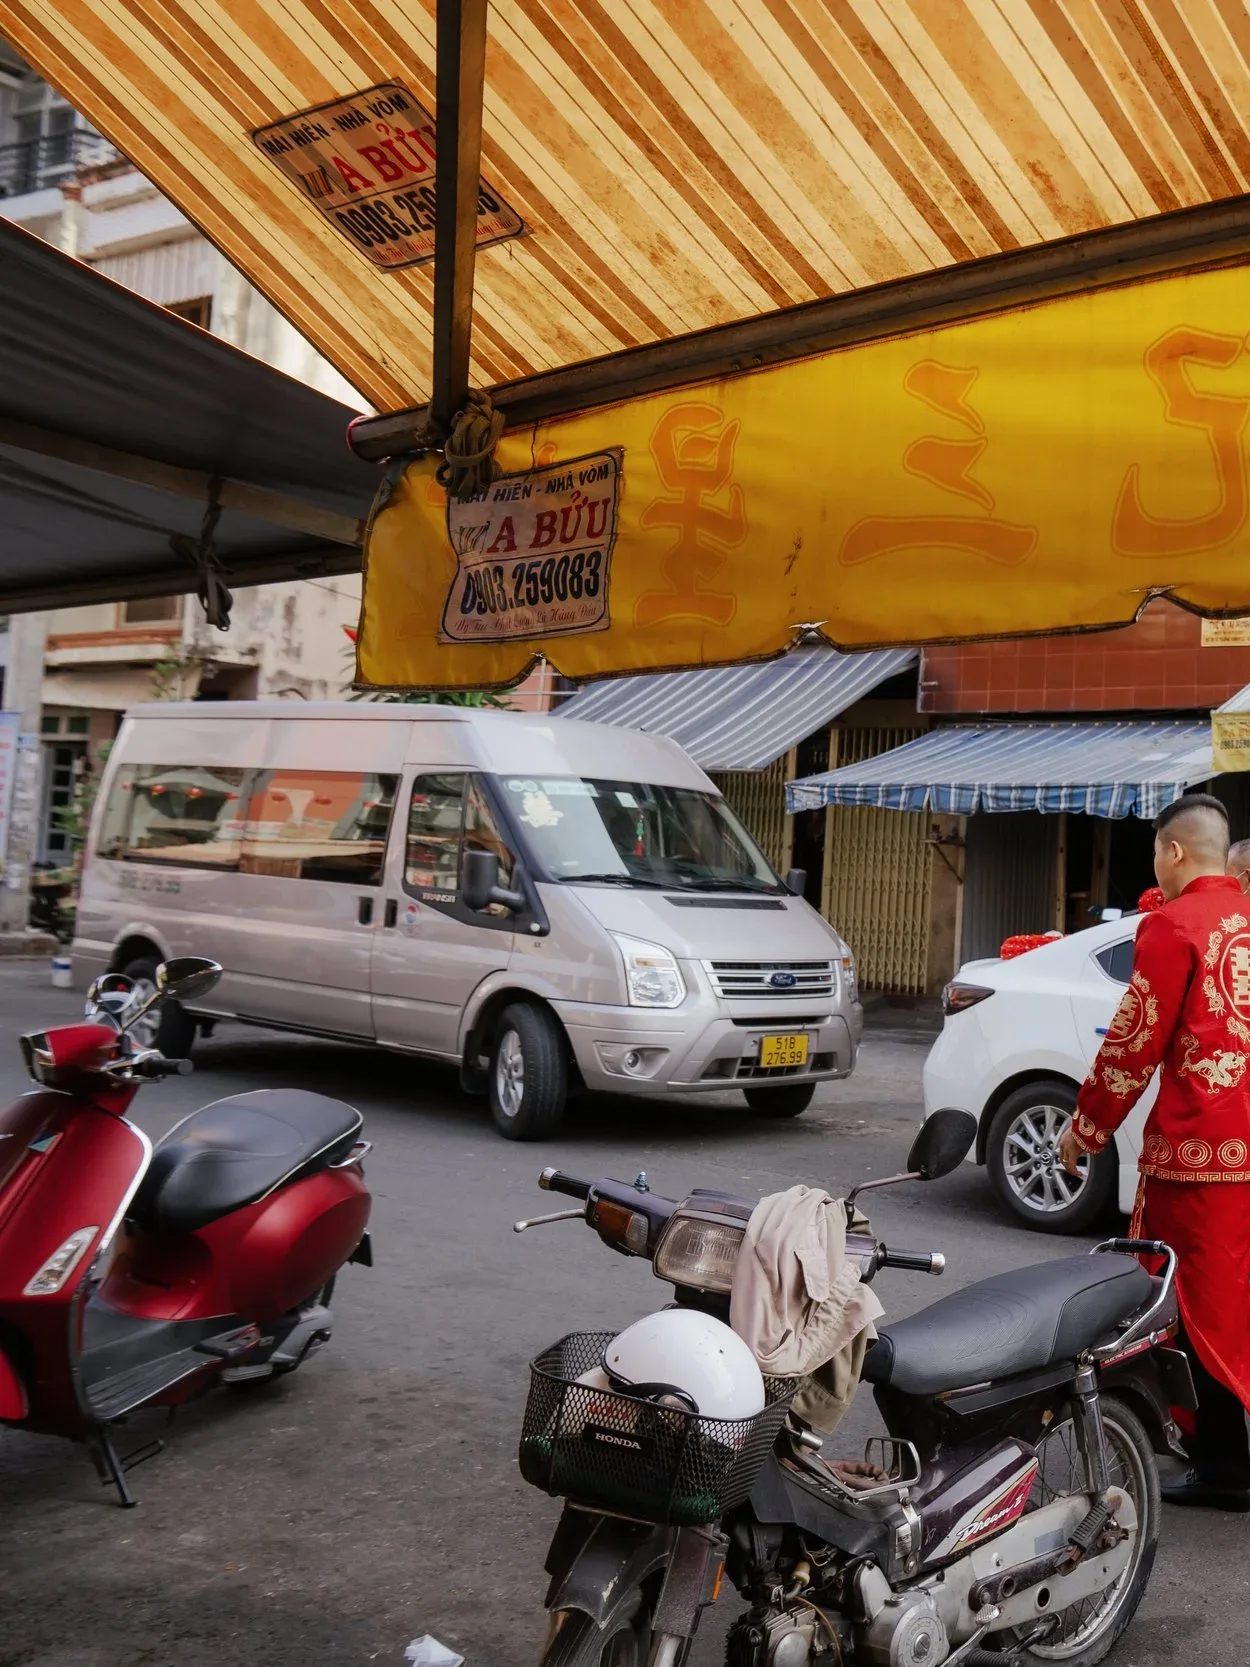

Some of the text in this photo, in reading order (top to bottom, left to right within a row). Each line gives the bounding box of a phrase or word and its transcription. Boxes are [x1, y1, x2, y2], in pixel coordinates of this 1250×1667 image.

[288, 121, 330, 147] HIÊN
[332, 106, 371, 132] NHÀ
[366, 94, 411, 119] VÒM
[332, 156, 376, 193] A
[493, 482, 533, 502] HIÊN
[545, 471, 574, 494] NHÀ
[579, 463, 609, 486] VÒM
[487, 490, 611, 554] A BỬU
[460, 551, 602, 615] 0903.259083
[766, 1051, 803, 1066] 276.99
[595, 1432, 642, 1450] HONDA
[956, 1503, 1013, 1542] Dream
